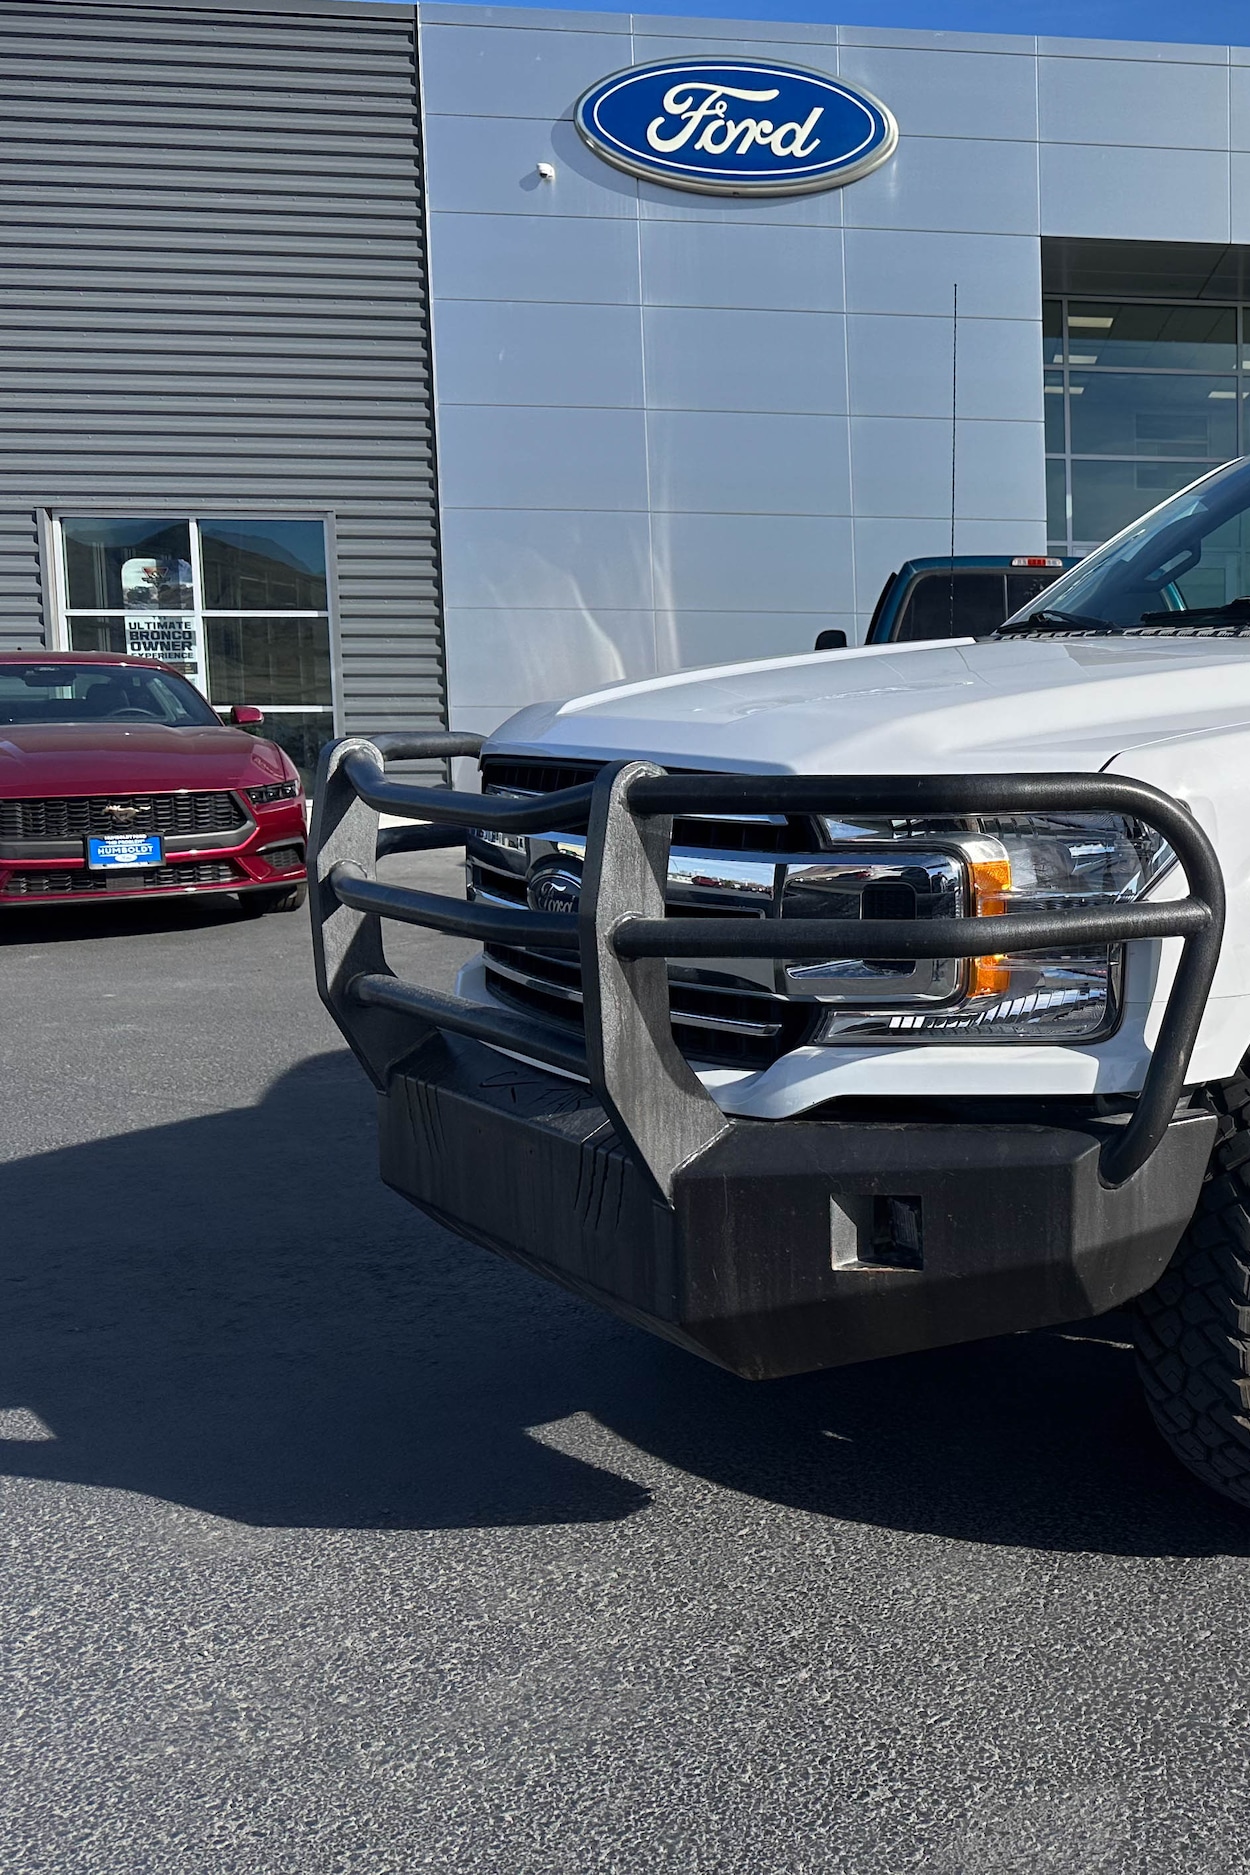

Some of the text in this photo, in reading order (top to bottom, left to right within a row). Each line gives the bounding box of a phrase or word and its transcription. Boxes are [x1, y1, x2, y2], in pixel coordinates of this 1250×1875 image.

[646, 82, 824, 158] Ford
[128, 621, 192, 630] ULTIMATE
[129, 630, 193, 640] BRONCO
[130, 641, 193, 651] OWNER
[97, 846, 154, 855] HUMBOLDT
